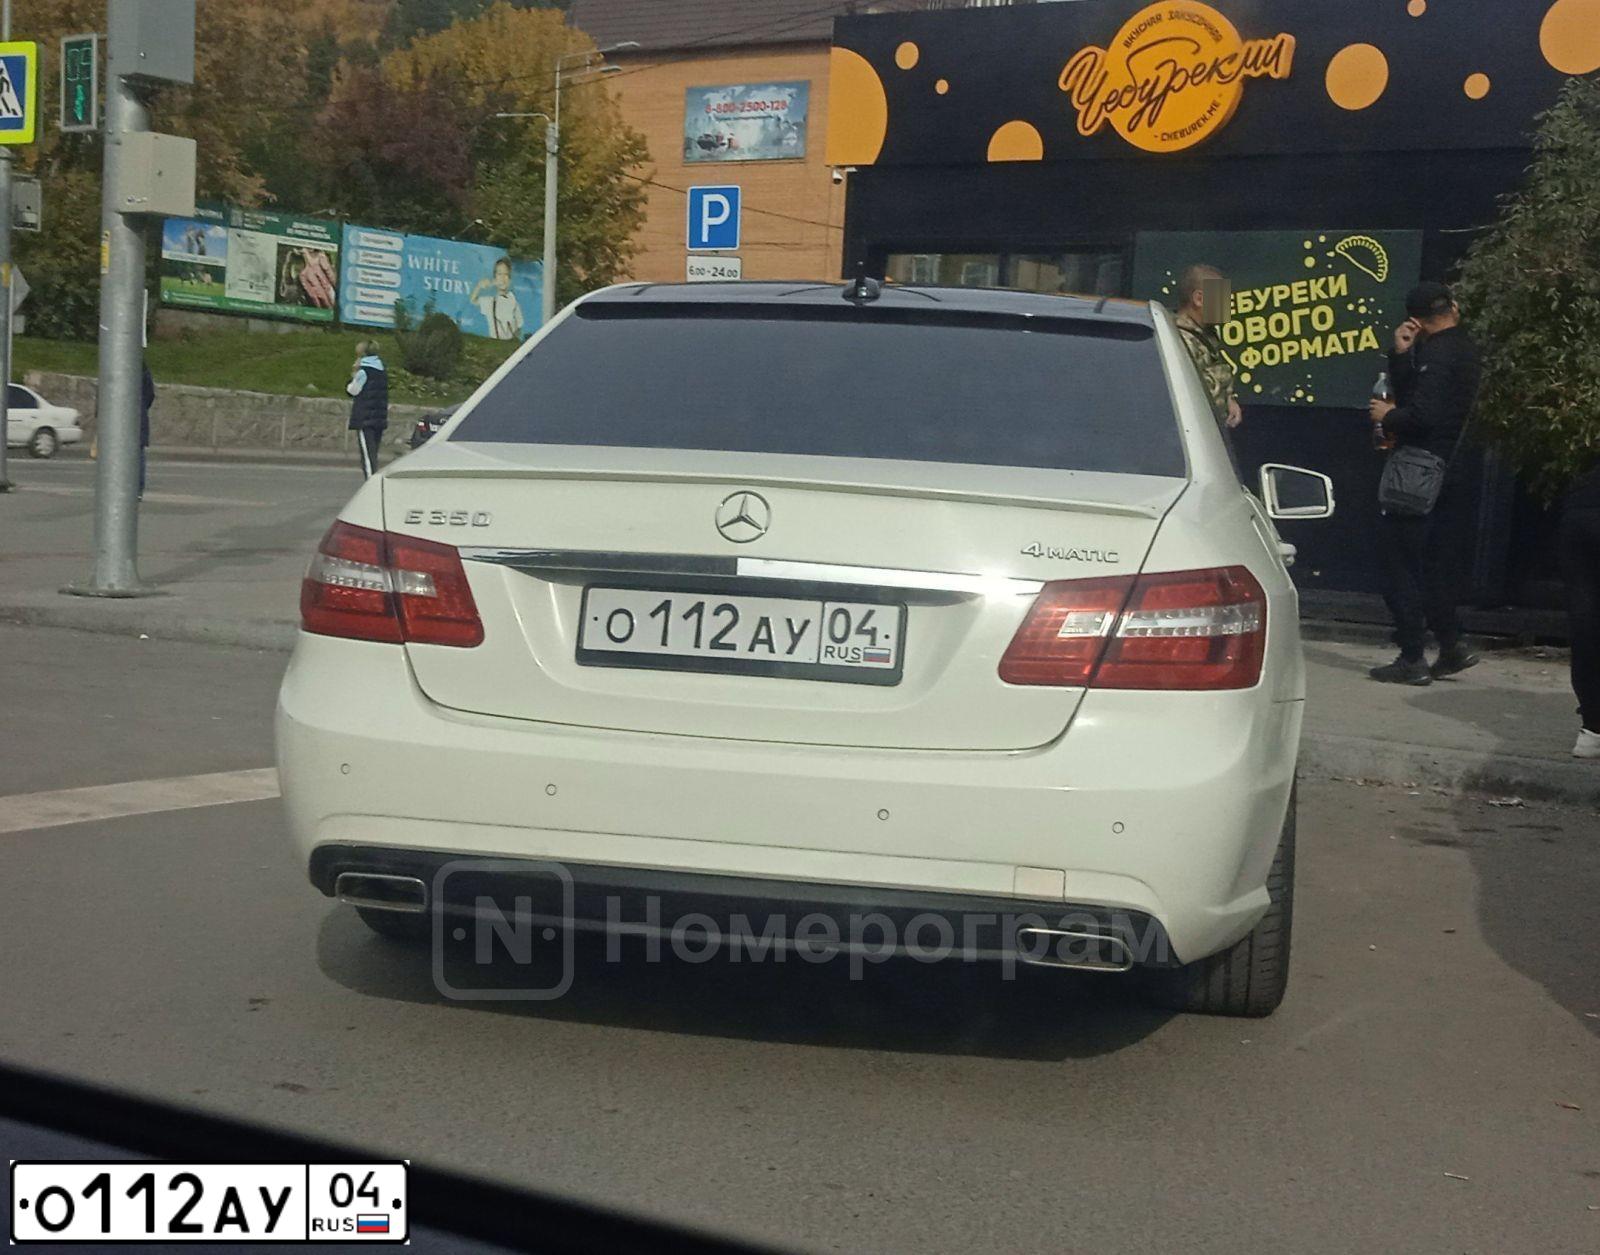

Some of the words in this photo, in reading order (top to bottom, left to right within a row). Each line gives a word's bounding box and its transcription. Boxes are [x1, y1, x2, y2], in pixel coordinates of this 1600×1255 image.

[1122, 12, 1163, 49] ВКУСНАЯ
[701, 193, 731, 243] P
[423, 276, 473, 295] STORY
[1230, 273, 1348, 315] БУРЕКИ
[1239, 325, 1380, 370] ФОРМАТА
[404, 510, 424, 525] E
[427, 510, 493, 528] 350
[1020, 541, 1120, 564] 4MATIC
[828, 607, 878, 647] 04
[824, 645, 862, 662] RUS
